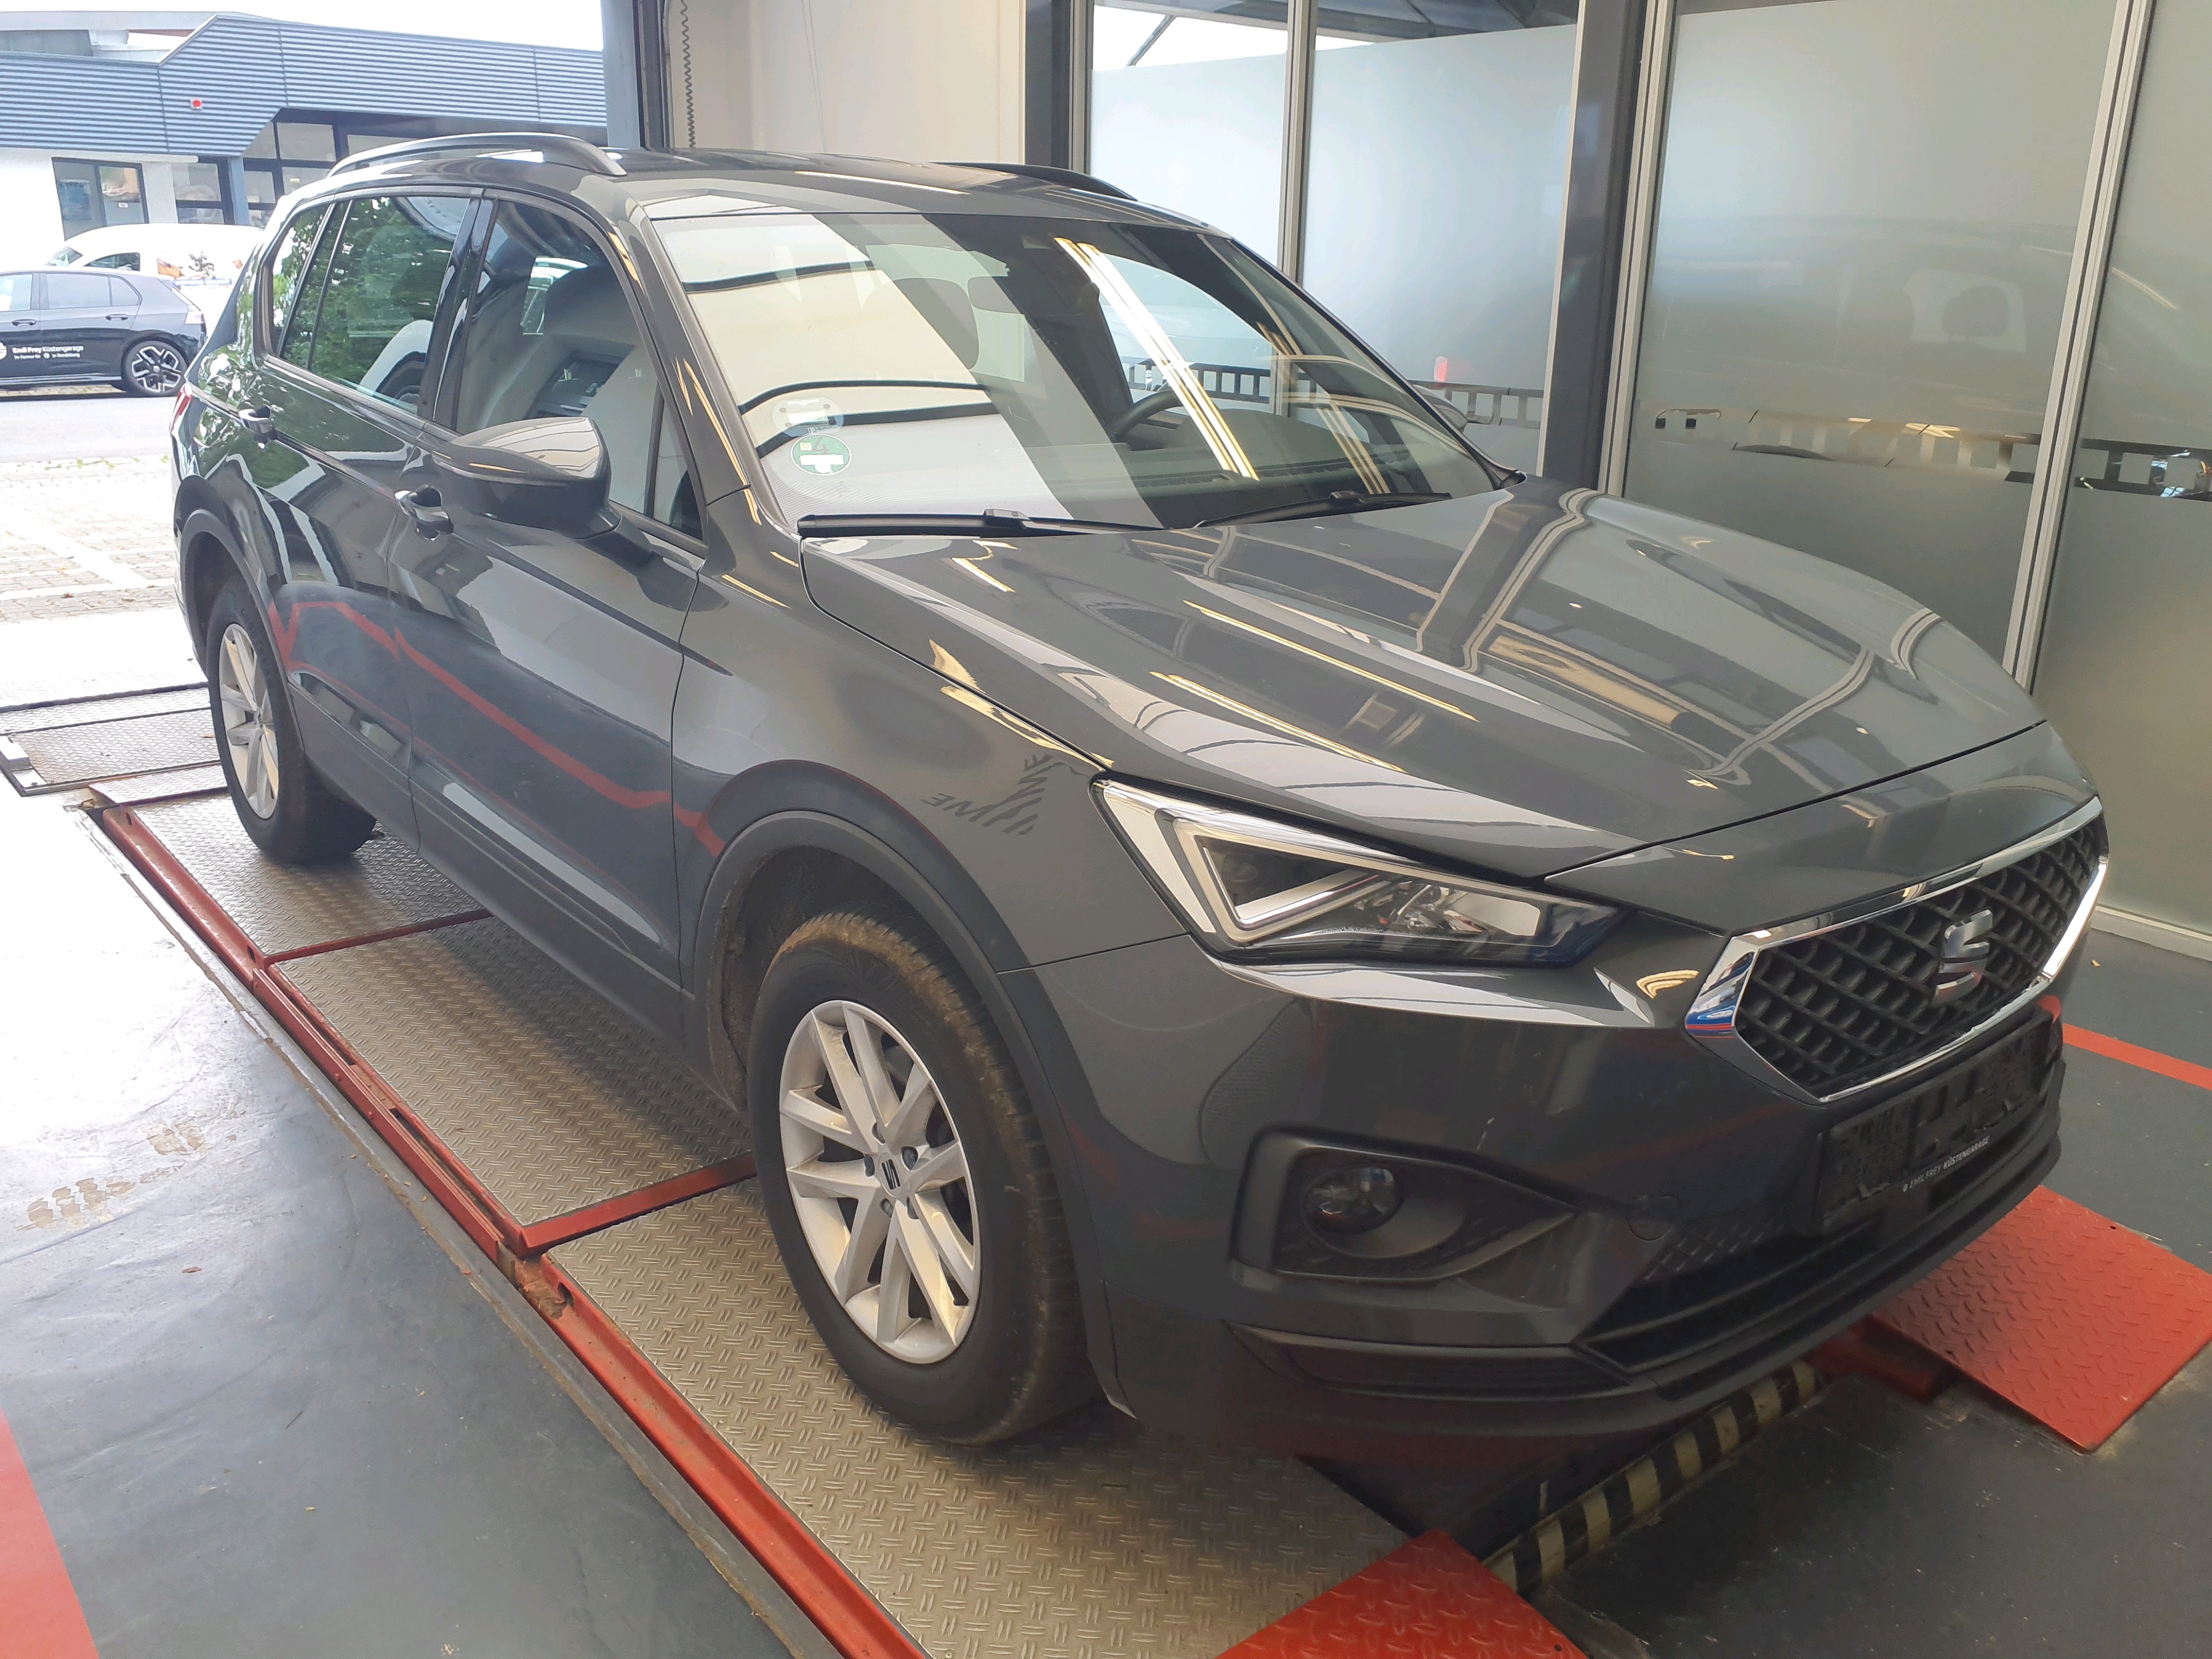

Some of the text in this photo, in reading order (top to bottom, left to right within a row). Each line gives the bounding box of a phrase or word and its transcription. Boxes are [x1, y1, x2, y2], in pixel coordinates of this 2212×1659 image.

[813, 436, 828, 455] 4
[1910, 1135, 1990, 1188] EMIL FREY KÜSTENGARAGE
